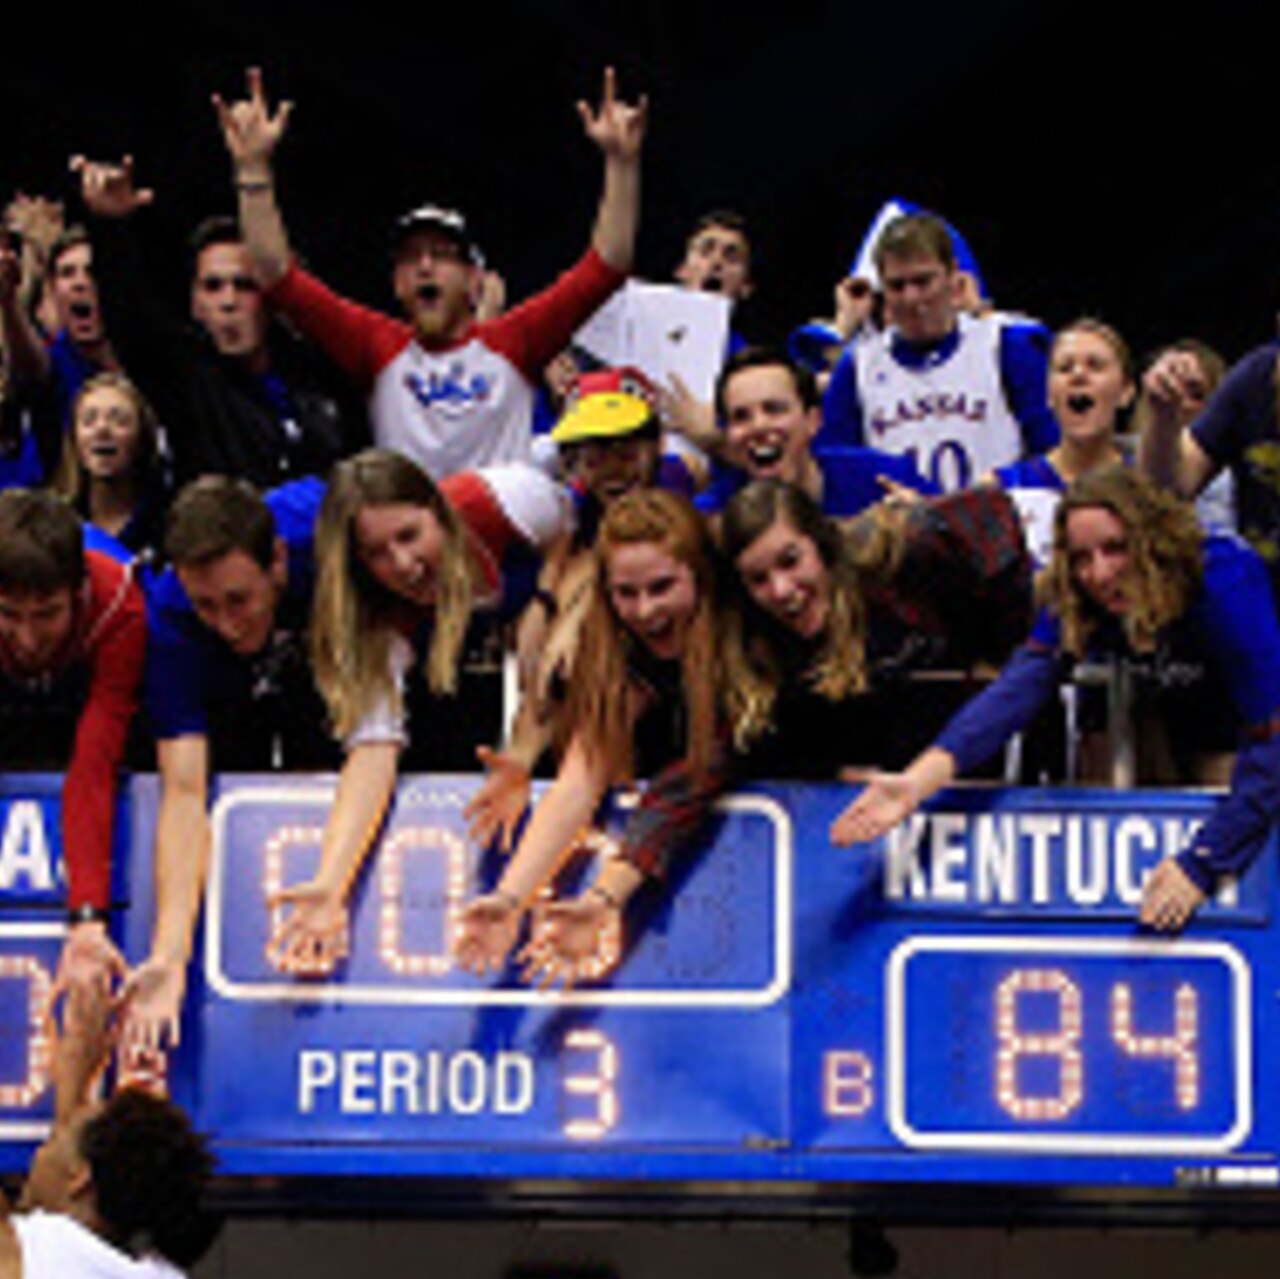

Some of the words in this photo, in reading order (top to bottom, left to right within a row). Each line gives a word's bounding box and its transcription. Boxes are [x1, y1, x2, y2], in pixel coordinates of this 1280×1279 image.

[904, 439, 972, 494] 0
[884, 812, 1238, 906] KENTUC
[298, 1049, 535, 1115] PERIOD
[562, 1028, 618, 1141] 3
[823, 1051, 873, 1115] B
[994, 967, 1198, 1120] 84
